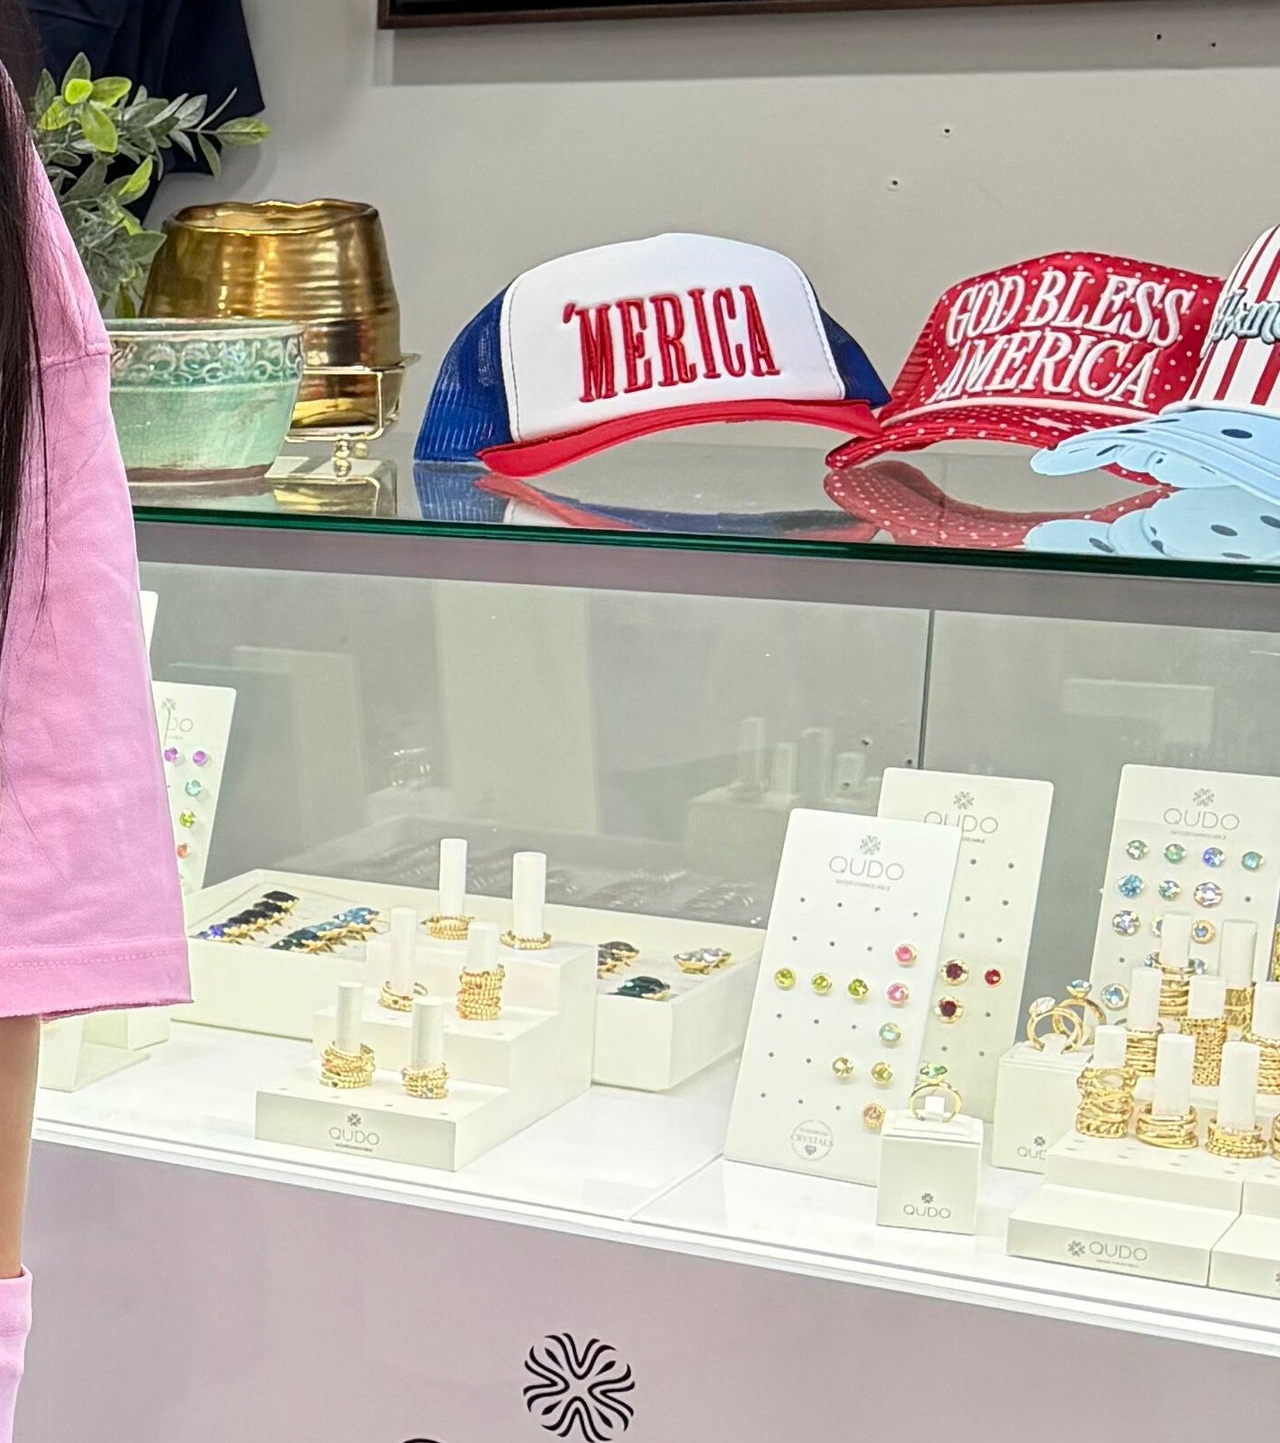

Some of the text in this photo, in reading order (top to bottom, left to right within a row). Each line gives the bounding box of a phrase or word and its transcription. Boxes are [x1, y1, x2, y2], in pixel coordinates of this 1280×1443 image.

[945, 271, 1025, 347] GOD
[1020, 269, 1196, 348] BLESS
[925, 330, 1164, 409] AMERICA
[1162, 807, 1240, 831] QUDO
[829, 855, 905, 881] QUDO
[328, 1127, 380, 1146] QUDO
[902, 1203, 952, 1220] QUDO
[1088, 1241, 1148, 1262] QUDO
